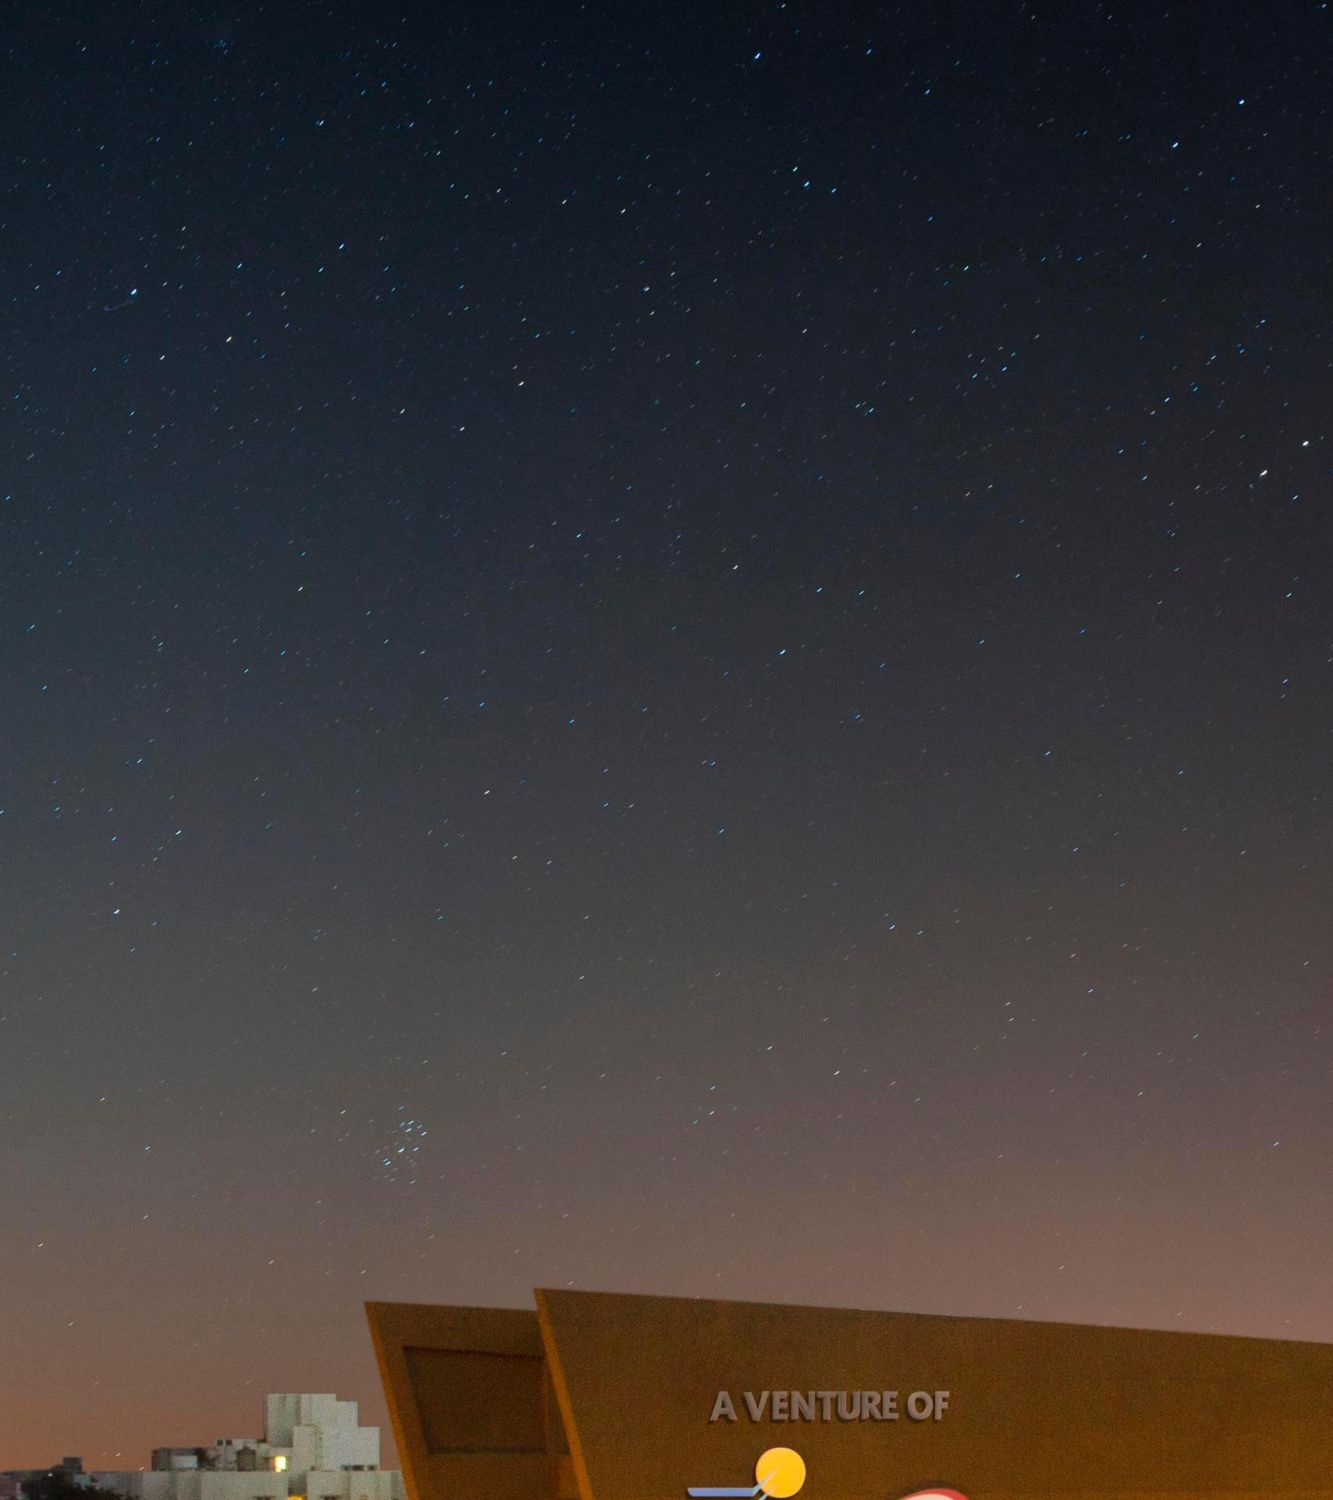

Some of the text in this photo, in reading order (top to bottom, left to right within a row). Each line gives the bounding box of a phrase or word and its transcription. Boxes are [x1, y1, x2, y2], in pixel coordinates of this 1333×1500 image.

[710, 1390, 950, 1422] A VENTURE OF
